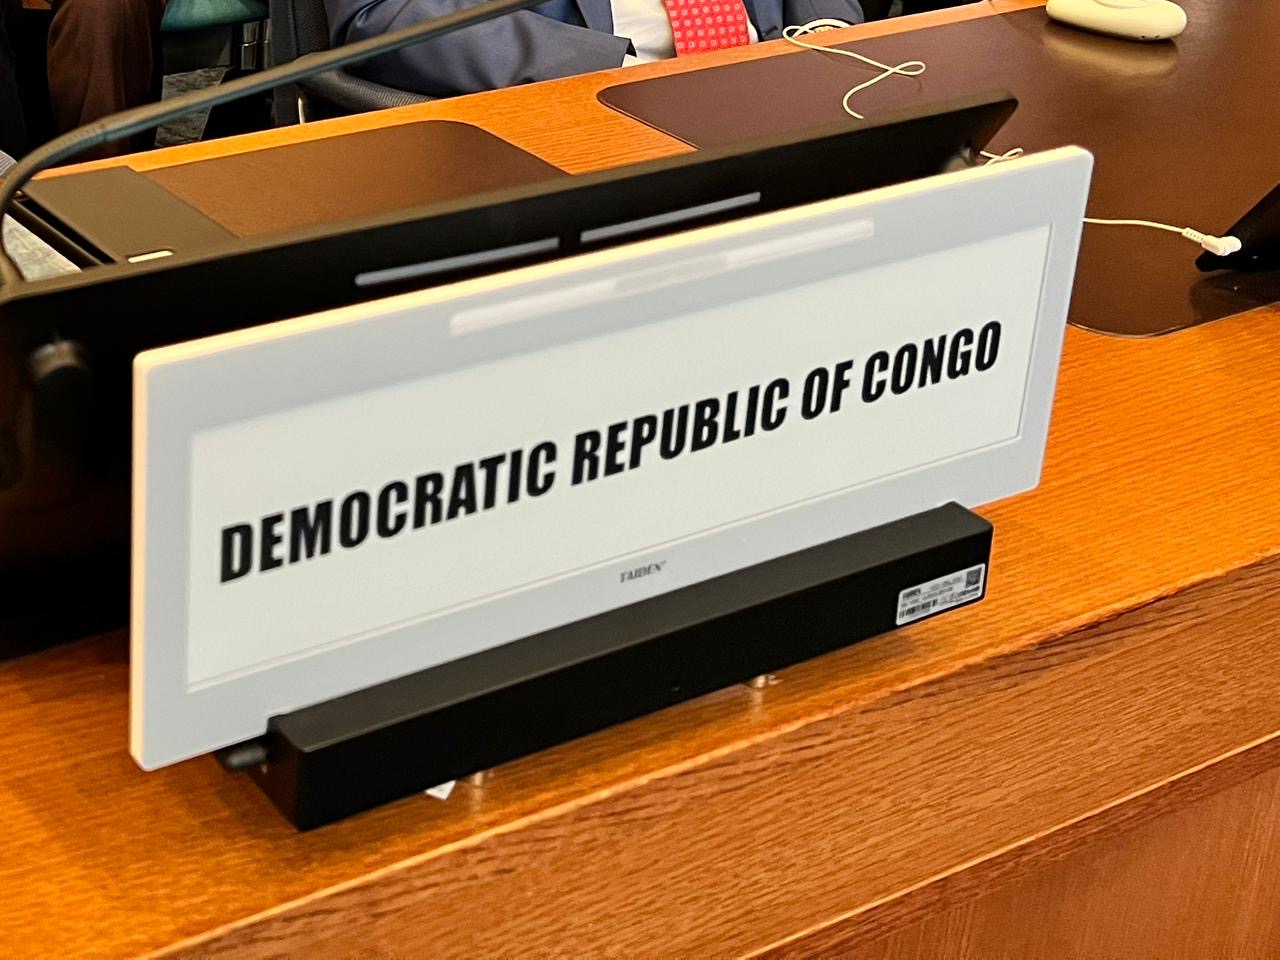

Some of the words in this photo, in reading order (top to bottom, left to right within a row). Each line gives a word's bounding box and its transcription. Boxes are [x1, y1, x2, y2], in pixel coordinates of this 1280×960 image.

[220, 442, 557, 583] DEMOCRATIC
[572, 377, 790, 487] REPUBLIC
[801, 360, 854, 421] OF
[862, 320, 1002, 403] CONGO
